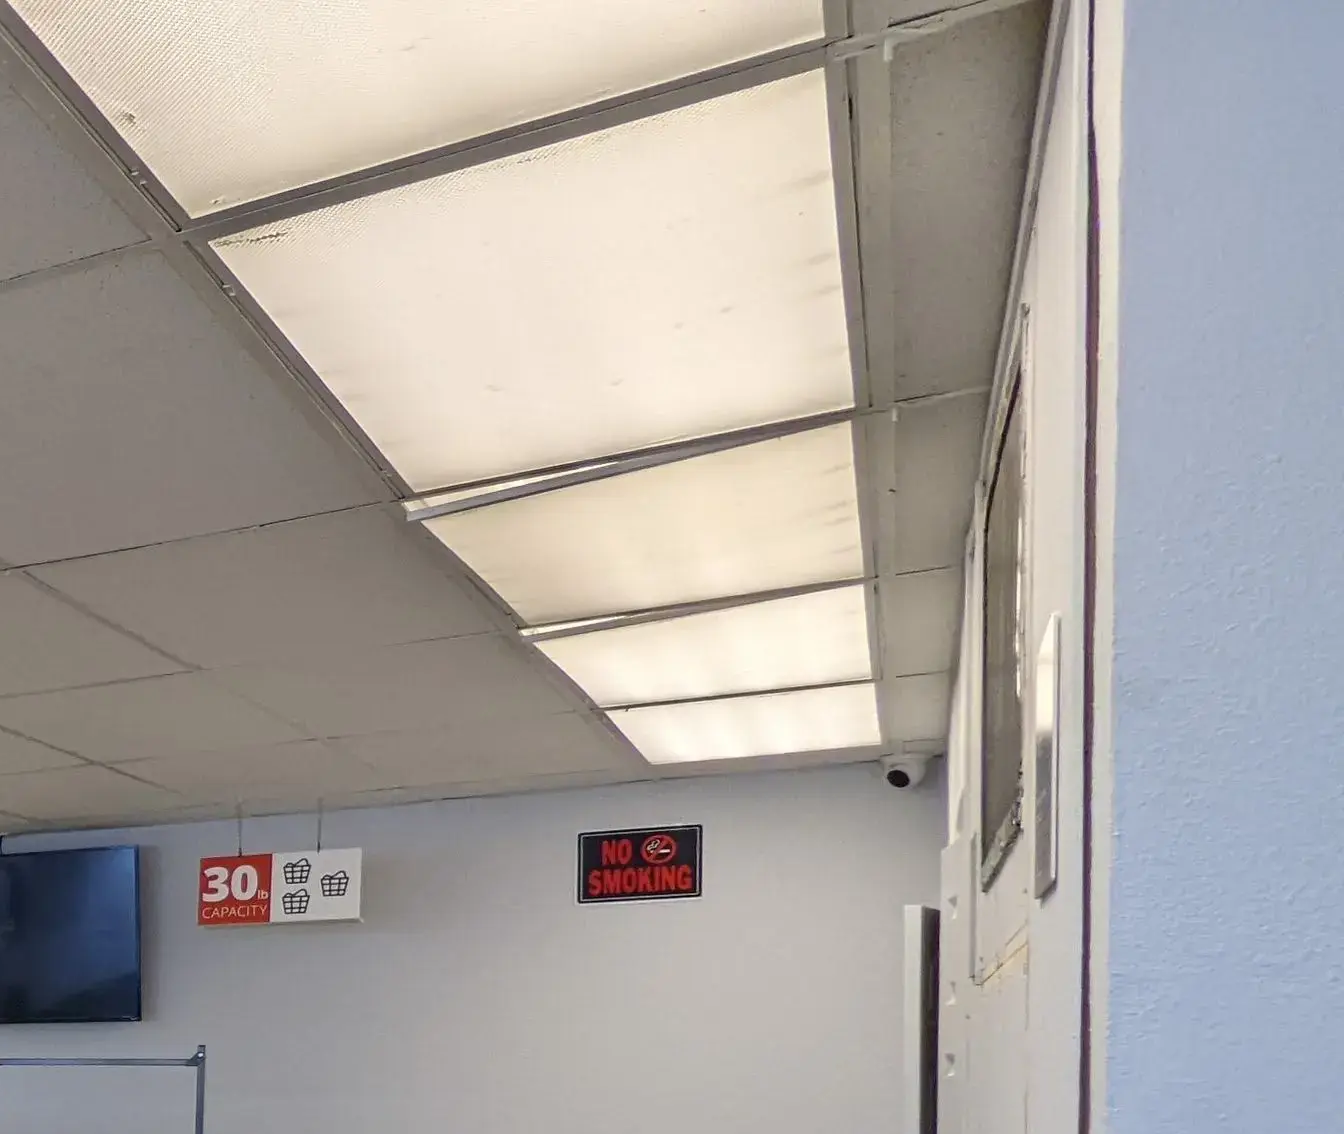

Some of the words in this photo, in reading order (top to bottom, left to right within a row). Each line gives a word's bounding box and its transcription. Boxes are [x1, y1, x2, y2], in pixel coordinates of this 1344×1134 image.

[601, 839, 632, 865] NO
[202, 864, 258, 902] 30
[588, 864, 693, 896] SMOKING
[202, 903, 268, 919] CAPACITY
